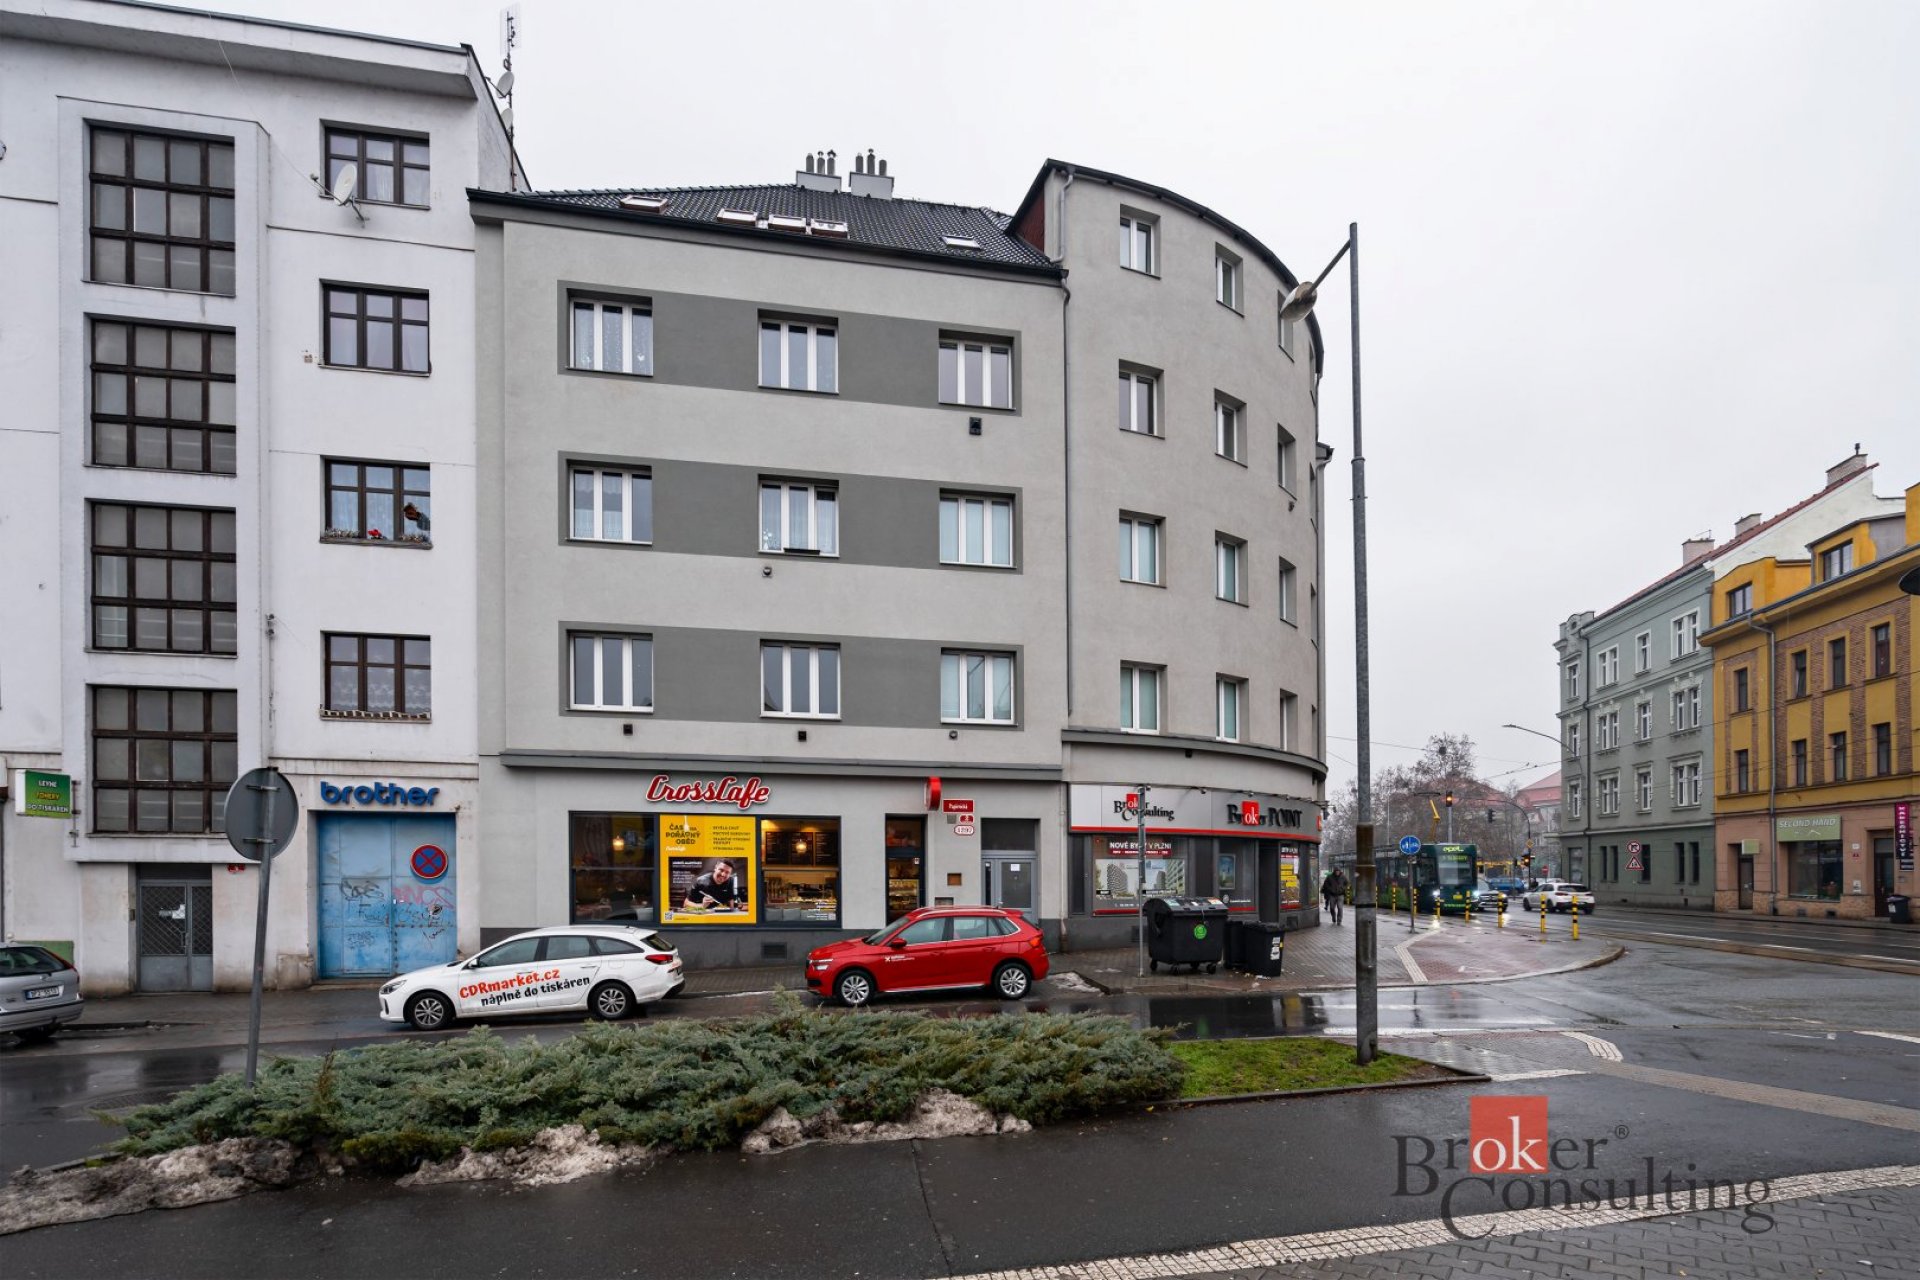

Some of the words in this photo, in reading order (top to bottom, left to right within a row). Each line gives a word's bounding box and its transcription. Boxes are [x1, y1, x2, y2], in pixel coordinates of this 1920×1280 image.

[320, 781, 440, 806] brother
[646, 775, 770, 810] CrossCafe
[1113, 797, 1150, 813] Brokr
[1122, 805, 1175, 821] Cosulting
[1268, 807, 1302, 828] POINT
[1779, 819, 1810, 828] SECOND
[1812, 818, 1836, 826] HAND
[1110, 841, 1128, 849] NOVÉ
[460, 969, 560, 999] CDRmarket.cz
[481, 989, 521, 1006] náplně
[525, 986, 538, 998] do
[541, 977, 590, 993] tiskáren
